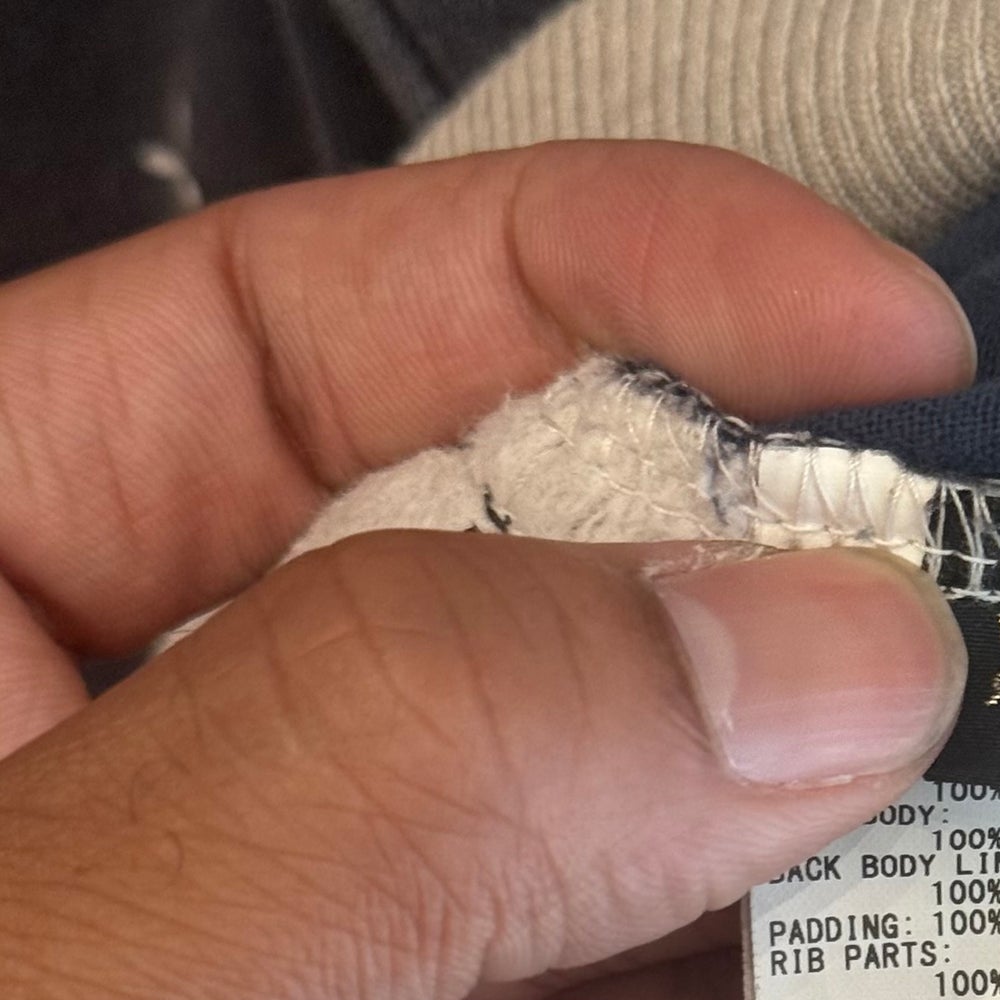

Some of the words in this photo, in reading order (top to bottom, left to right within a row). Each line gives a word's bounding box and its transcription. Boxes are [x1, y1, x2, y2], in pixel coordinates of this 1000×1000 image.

[861, 855, 935, 879] BODY
[768, 914, 914, 946] PADDING:
[769, 949, 825, 976] RIB
[844, 942, 951, 971] PARTS:
